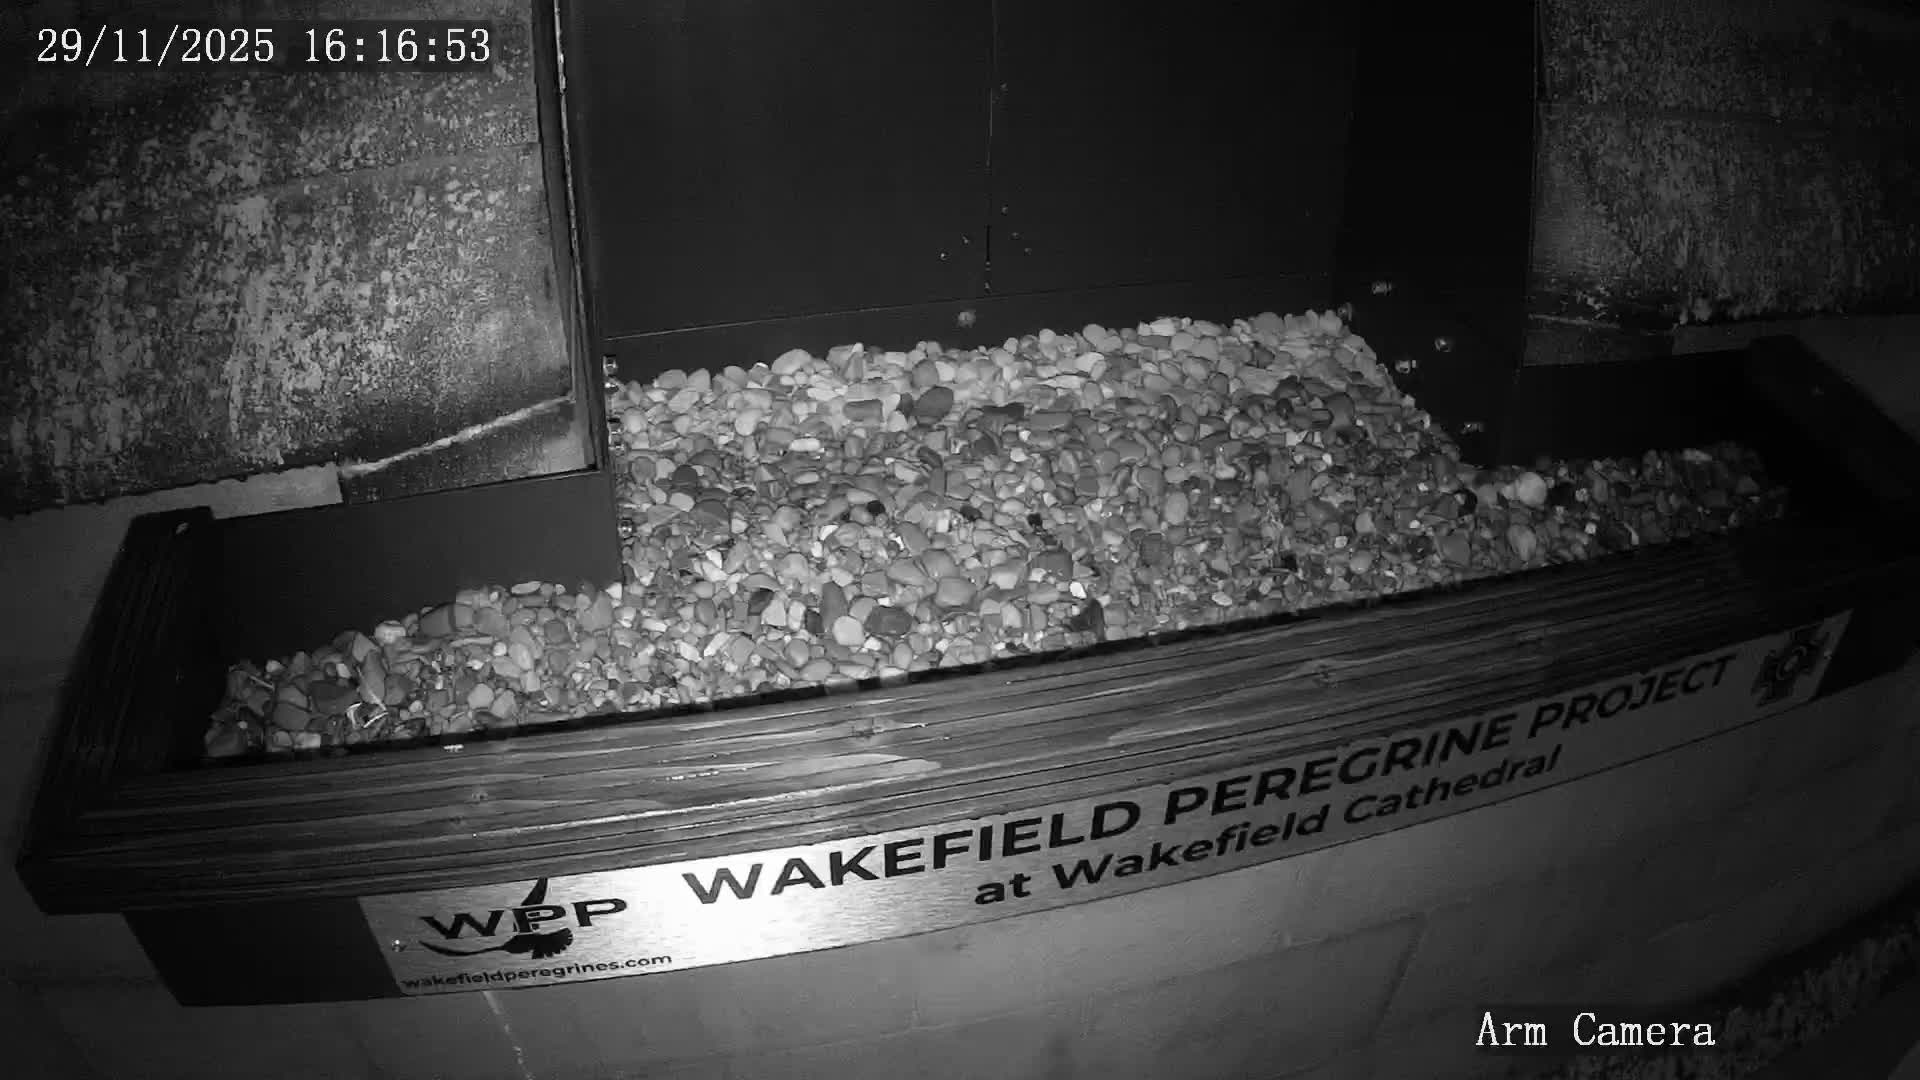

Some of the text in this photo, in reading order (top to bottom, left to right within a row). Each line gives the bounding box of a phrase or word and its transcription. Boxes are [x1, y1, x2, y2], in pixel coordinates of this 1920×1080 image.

[682, 654, 1736, 904] WAKEFIELD PEREGRINE PROJECT
[974, 744, 1562, 905] at Wakefield Cathedral
[419, 898, 627, 940] WPP
[401, 954, 673, 989] wakefieldperegrines.com
